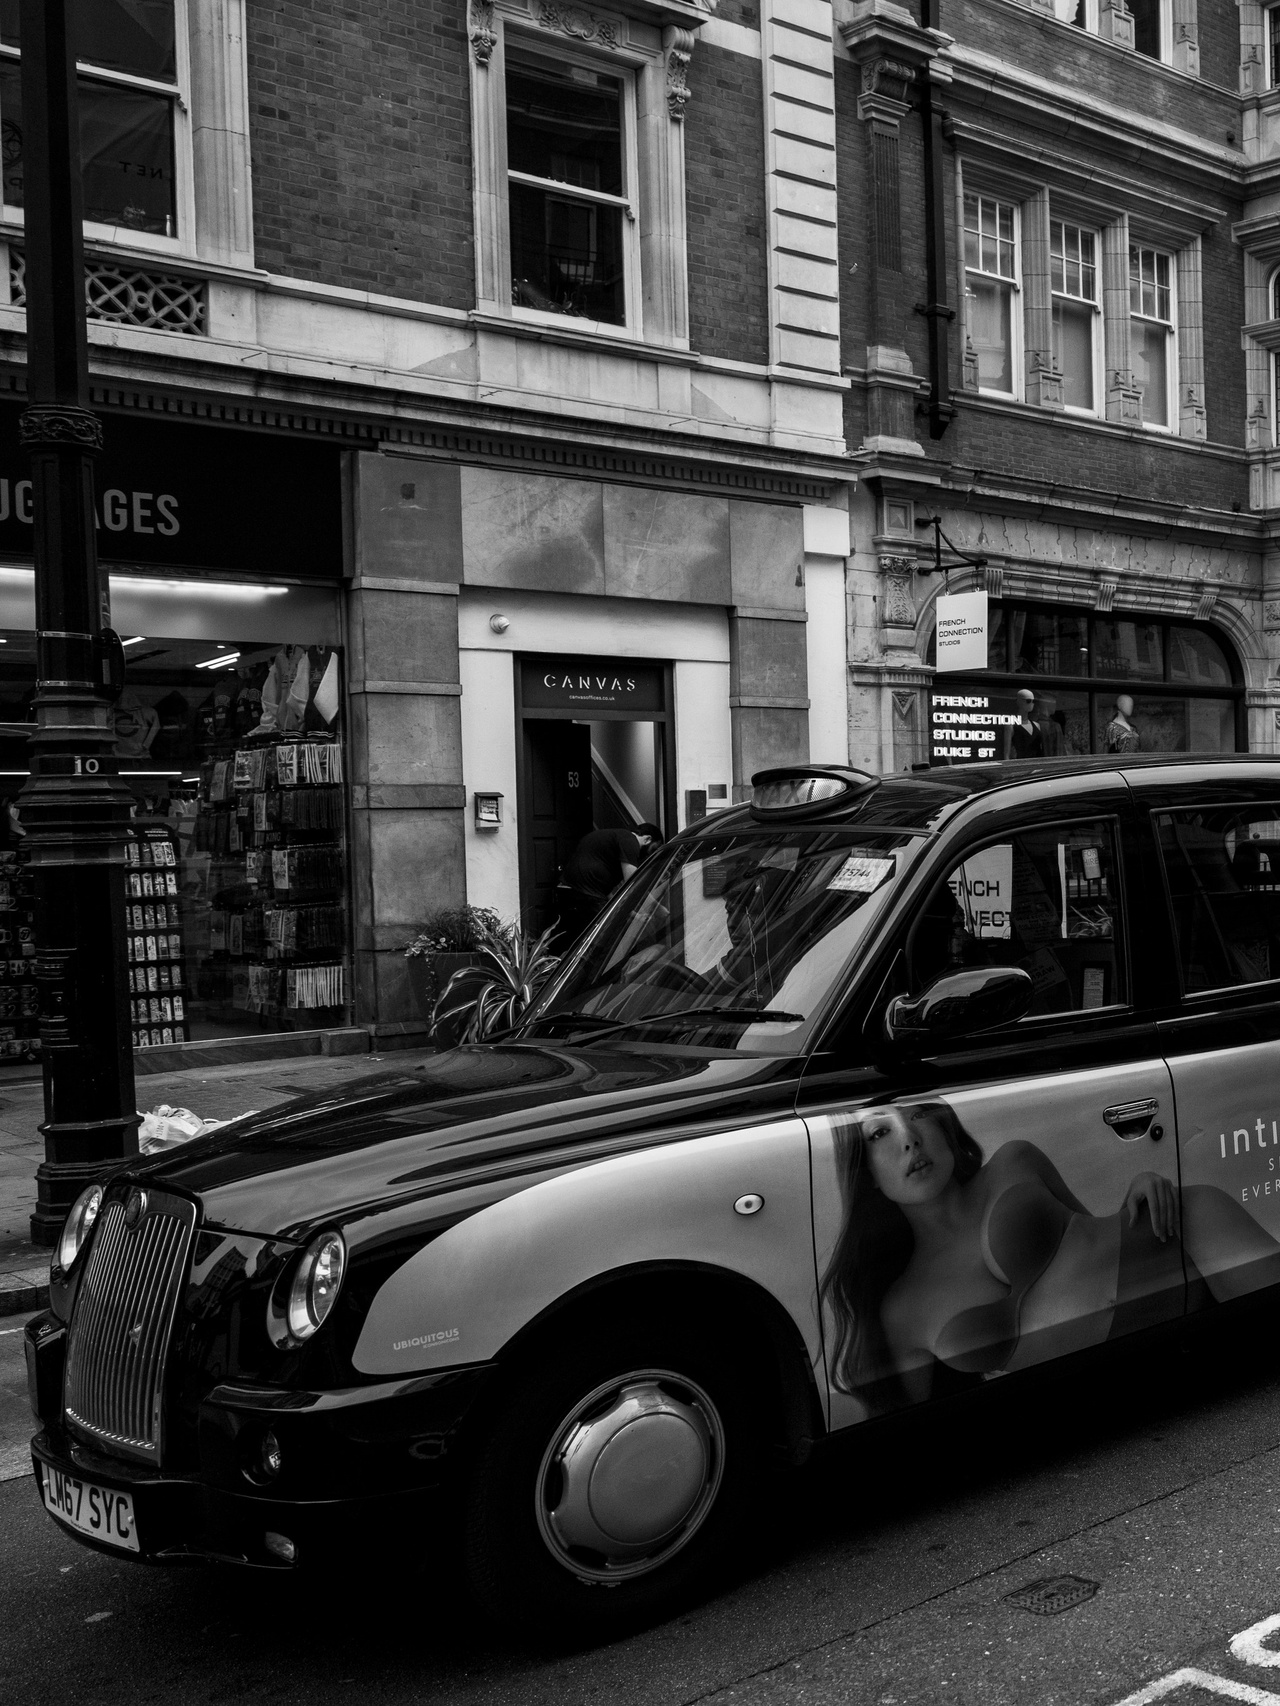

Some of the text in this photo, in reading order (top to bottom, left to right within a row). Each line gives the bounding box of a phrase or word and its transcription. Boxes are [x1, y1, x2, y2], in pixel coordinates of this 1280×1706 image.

[0, 478, 181, 536] GGES
[938, 618, 966, 627] FRENCH
[938, 627, 984, 638] CONNECTION
[938, 639, 961, 647] STUDIOS
[544, 673, 636, 692] CANVAS
[568, 694, 616, 702] canvasoffices.co.uk
[932, 695, 989, 708] FRENCH
[932, 712, 1022, 725] CONNECTION
[933, 729, 996, 741] STUDIOS
[933, 746, 996, 758] DUKE ST
[73, 757, 100, 775] 10
[567, 771, 580, 789] 53
[759, 779, 816, 807] TAXI
[1083, 848, 1097, 857] FOR
[1084, 857, 1099, 866] HIRE
[393, 1327, 460, 1351] UBIQUITOUS
[46, 1465, 130, 1539] LM67 SYC
